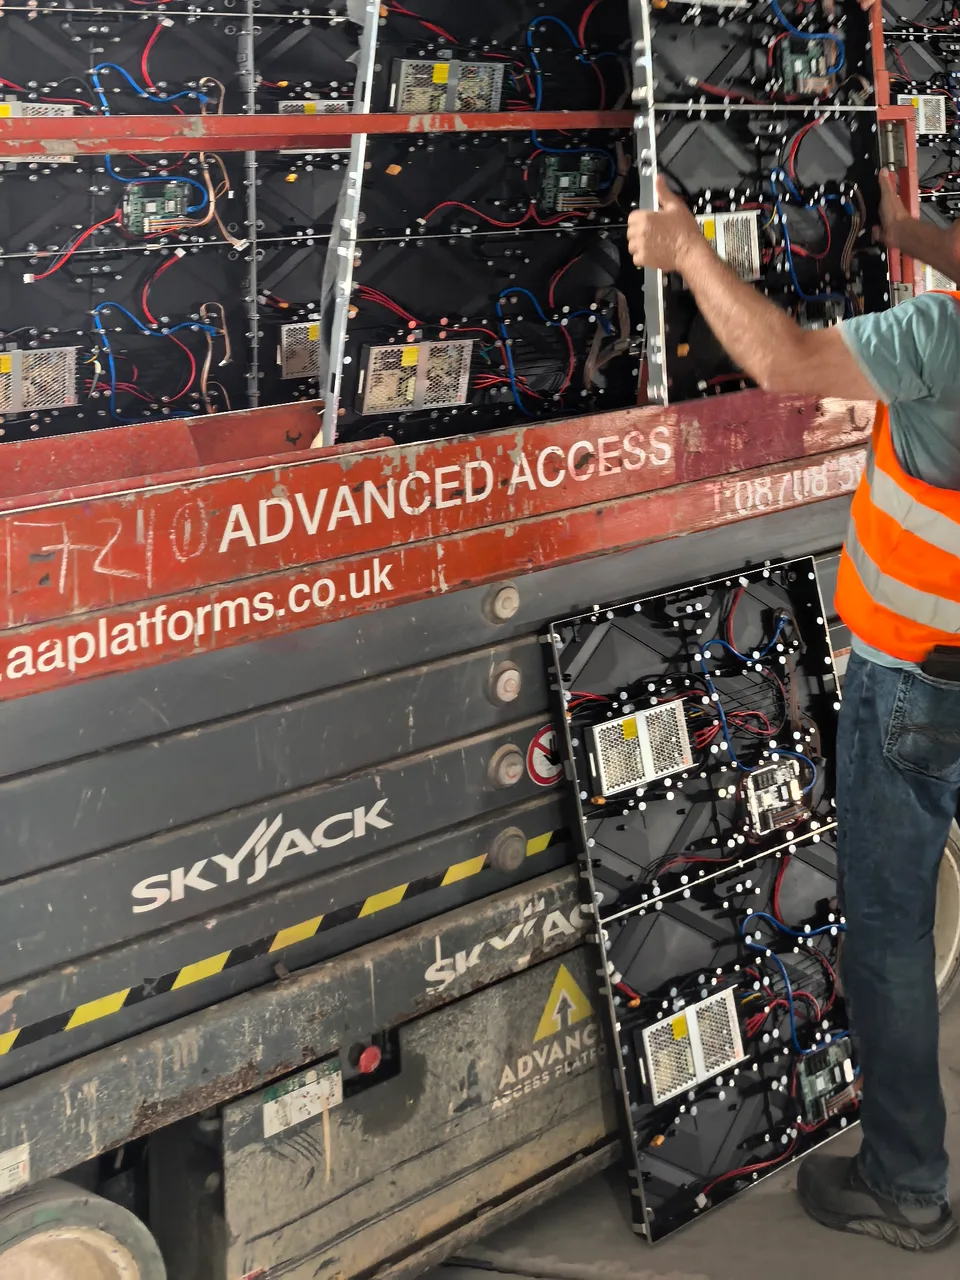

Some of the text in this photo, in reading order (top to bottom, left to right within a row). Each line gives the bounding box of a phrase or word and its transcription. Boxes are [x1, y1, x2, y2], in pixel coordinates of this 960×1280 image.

[218, 425, 672, 553] ADVANCED ACCESS
[0, 554, 394, 682] aaplatforms.co.uk
[131, 797, 394, 914] SKYJACK
[498, 1023, 600, 1090] ADVANC
[554, 1043, 607, 1078] PLATFO
